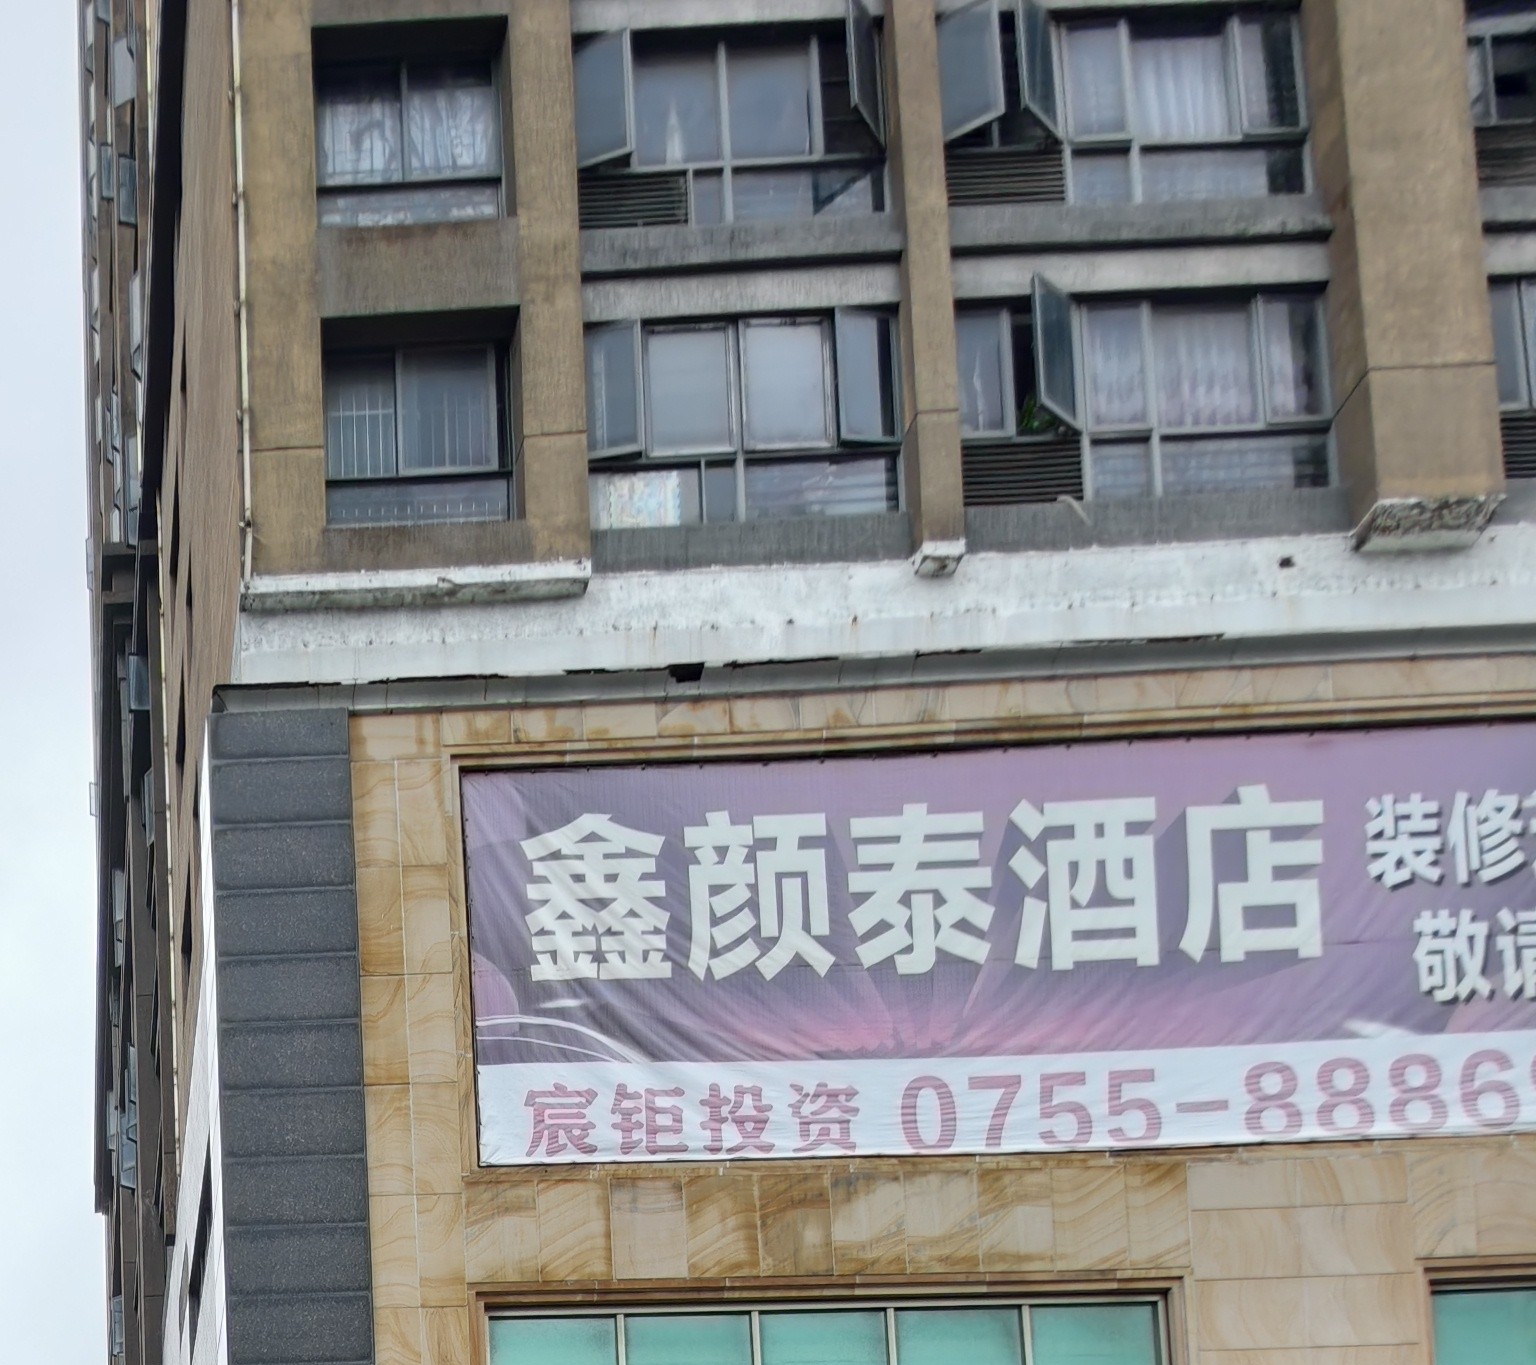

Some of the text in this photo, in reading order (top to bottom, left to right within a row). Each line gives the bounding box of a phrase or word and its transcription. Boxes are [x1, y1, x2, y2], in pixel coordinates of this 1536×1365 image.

[520, 784, 1324, 983] 鑫颜泰酒店
[1365, 788, 1536, 888] 装修
[522, 1049, 1536, 1159] 宸钜投资 0755-8886
